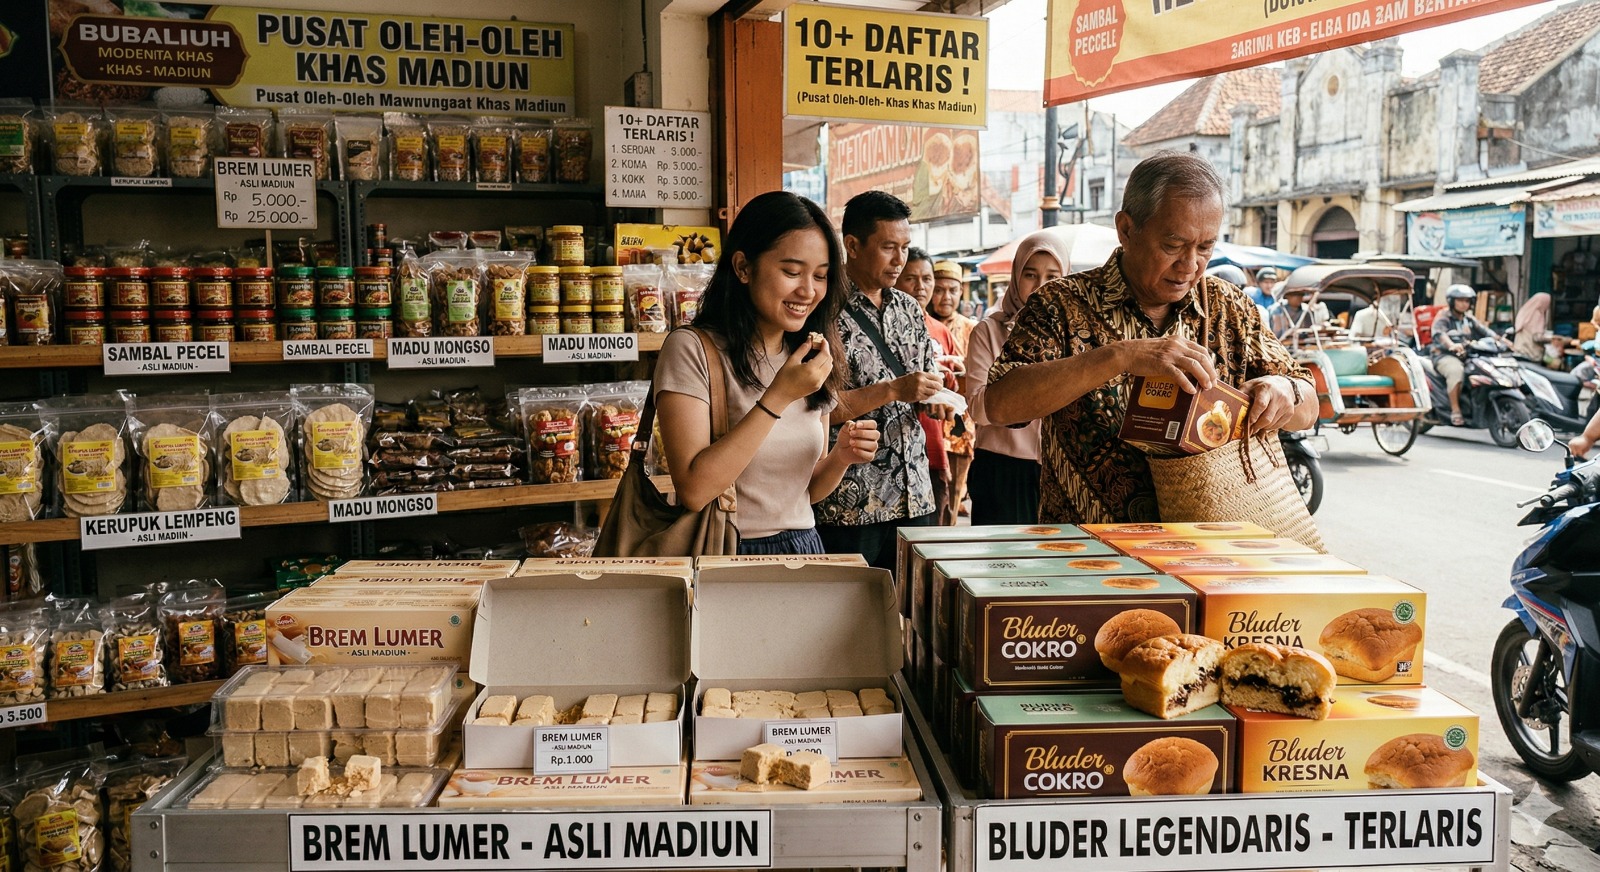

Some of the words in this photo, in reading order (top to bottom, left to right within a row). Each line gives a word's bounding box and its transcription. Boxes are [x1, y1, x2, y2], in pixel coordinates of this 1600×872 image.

[1076, 5, 1118, 34] SAMBAL
[1277, 26, 1301, 49] KEB
[1310, 16, 1343, 41] ELBA
[1346, 9, 1371, 32] IDA
[79, 23, 230, 48] BUBALIUH
[257, 13, 368, 48] PUSAT
[379, 20, 563, 58] OLEH-OLEH
[795, 17, 853, 48] 10+
[865, 23, 980, 60] DAFTAR
[176, 51, 214, 63] KHAS
[106, 63, 143, 76] KHAS
[154, 65, 211, 78] MADIUN
[296, 52, 387, 85] KHAS
[398, 57, 530, 91] MADIUN
[805, 55, 952, 94] TERLARIS
[256, 88, 299, 104] Pusat
[304, 90, 375, 107] Oleh-Oleh
[476, 96, 511, 111] Khas
[514, 98, 566, 113] Madiun
[797, 91, 830, 104] (Pusat
[886, 97, 910, 109] Khas
[912, 98, 935, 110] Khas
[937, 100, 977, 115] Madiun)
[618, 114, 643, 125] 10+
[647, 115, 699, 129] DAFTAR
[623, 128, 687, 142] TERLARIS
[217, 161, 258, 176] BREM
[263, 162, 313, 178] LUMER
[240, 179, 260, 188] ASLI
[261, 180, 295, 189] MADIUN
[223, 191, 238, 203] Rp
[224, 210, 239, 222] Rp
[107, 345, 173, 361] SAMBAL
[177, 345, 225, 360] PECEL
[286, 344, 333, 355] SAMBAL
[335, 343, 371, 355] PECEL
[391, 341, 429, 355] MADU
[439, 338, 490, 354] MONGSO
[548, 337, 585, 351] MADU
[588, 336, 634, 350] MONGO
[422, 357, 438, 365] ASLI
[439, 357, 466, 365] MADIUN
[571, 352, 586, 360] ASLI
[142, 363, 161, 371] ASLI
[162, 363, 193, 371] MADIUN
[333, 501, 372, 518] MADU
[376, 496, 434, 514] MONGSO
[86, 515, 161, 536] KERUPUK
[165, 510, 236, 530] LEMPENG
[137, 533, 157, 542] ASLI
[1002, 615, 1080, 640] Bluder
[1227, 609, 1302, 634] Bluder
[308, 625, 367, 648] BREM
[374, 626, 445, 649] LUMER
[1001, 640, 1077, 660] COKRO
[542, 733, 568, 742] BREM
[570, 732, 602, 741] LUMER
[772, 727, 798, 736] BREM
[800, 726, 831, 735] LUMER
[1024, 745, 1106, 771] Bluder
[1267, 737, 1346, 763] Bluder
[551, 755, 593, 766] Rp.1.000
[497, 775, 562, 786] BREM
[571, 774, 651, 785] LUMER
[1023, 771, 1104, 791] COKRO
[1262, 763, 1350, 782] KRESNA
[303, 824, 391, 861] BREM
[402, 823, 510, 860] LUMER
[543, 821, 612, 859] ASLI
[624, 820, 759, 858] MADIUN
[988, 818, 1108, 860] BLUDER
[1119, 812, 1312, 857] LEGENDARIS
[1345, 807, 1483, 850] TERLARIS
